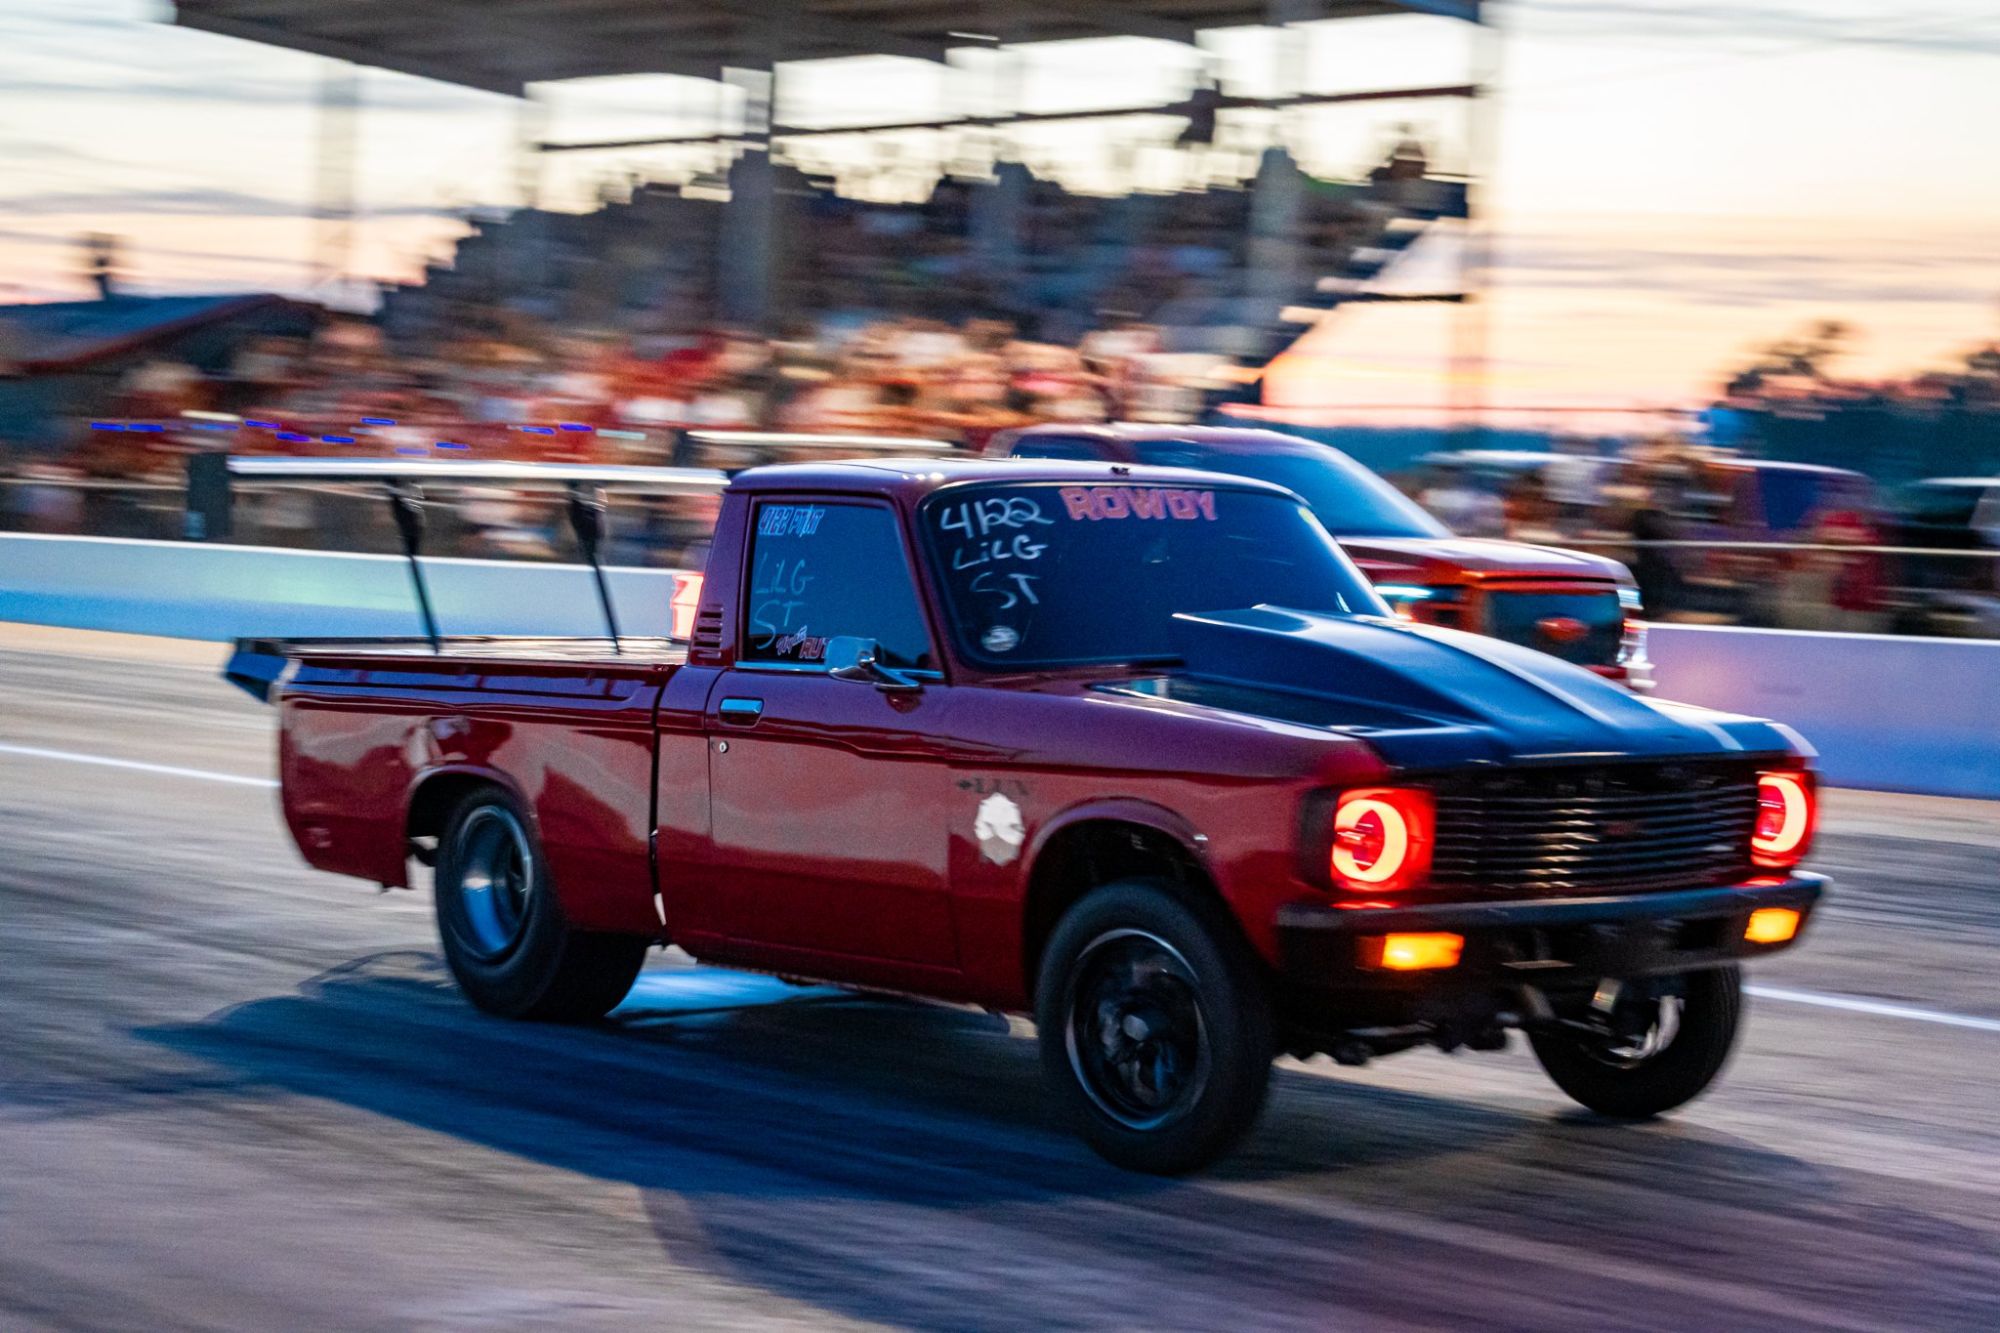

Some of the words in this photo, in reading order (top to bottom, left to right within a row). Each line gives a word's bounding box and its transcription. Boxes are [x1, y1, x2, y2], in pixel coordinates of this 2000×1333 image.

[940, 497, 1055, 538] 4122
[1059, 487, 1218, 521] ROWDY
[970, 572, 1039, 608] ST
[754, 600, 805, 650] ST
